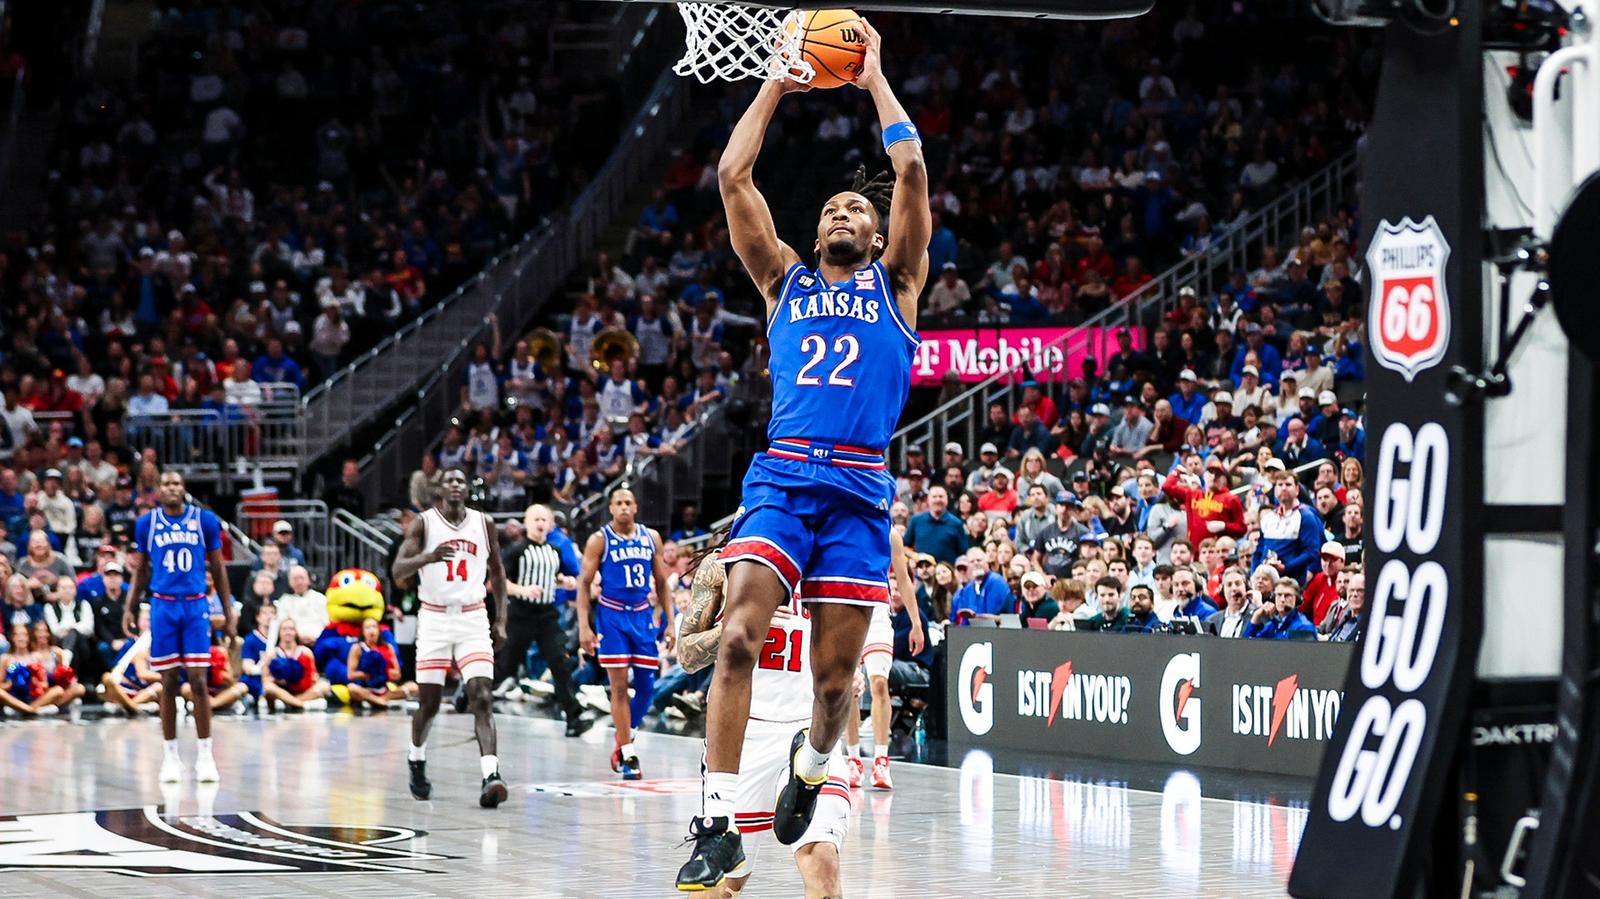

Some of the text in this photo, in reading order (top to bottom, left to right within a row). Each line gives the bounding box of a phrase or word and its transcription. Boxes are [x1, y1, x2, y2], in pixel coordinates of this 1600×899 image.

[1382, 243, 1435, 271] PHILLIPS
[798, 275, 815, 288] SW
[788, 291, 880, 324] KANSAS
[1383, 283, 1434, 343] 66
[795, 332, 861, 387] 22
[947, 336, 1064, 375] Mobile
[813, 447, 829, 459] KU
[1373, 421, 1450, 555] GO
[154, 530, 199, 548] KANSAS
[610, 546, 653, 563] KANSAS
[162, 547, 193, 573] 40
[446, 559, 468, 581] 14
[623, 563, 646, 588] 13
[1360, 559, 1449, 692] GO
[758, 626, 803, 672] 21
[958, 641, 994, 736] G
[1159, 652, 1202, 756] G
[1310, 689, 1344, 741] YO
[1328, 695, 1427, 830] GO.
